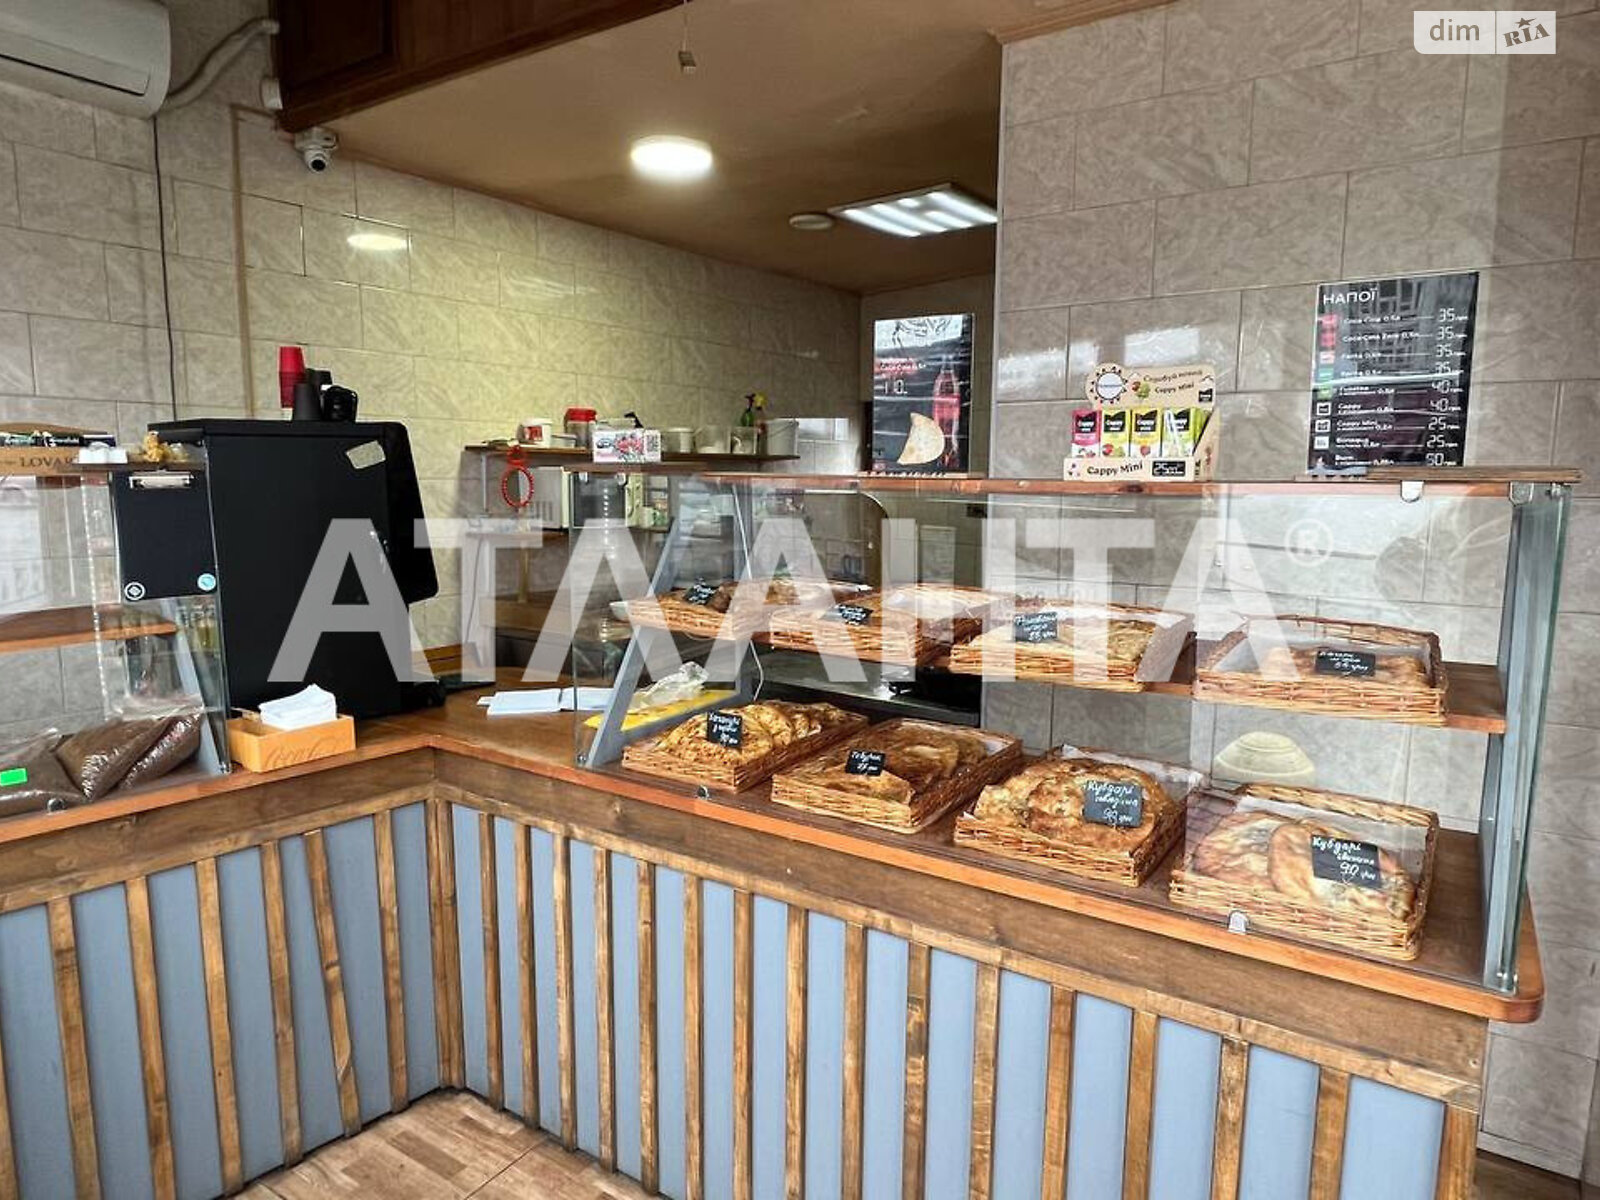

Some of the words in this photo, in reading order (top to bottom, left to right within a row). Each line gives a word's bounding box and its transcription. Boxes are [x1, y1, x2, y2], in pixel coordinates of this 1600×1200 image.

[1323, 287, 1379, 305] НАПОЇ
[1154, 386, 1177, 394] Cappy
[1178, 382, 1195, 390] Mini
[1086, 465, 1119, 476] Cappy
[1120, 460, 1144, 473] Mini
